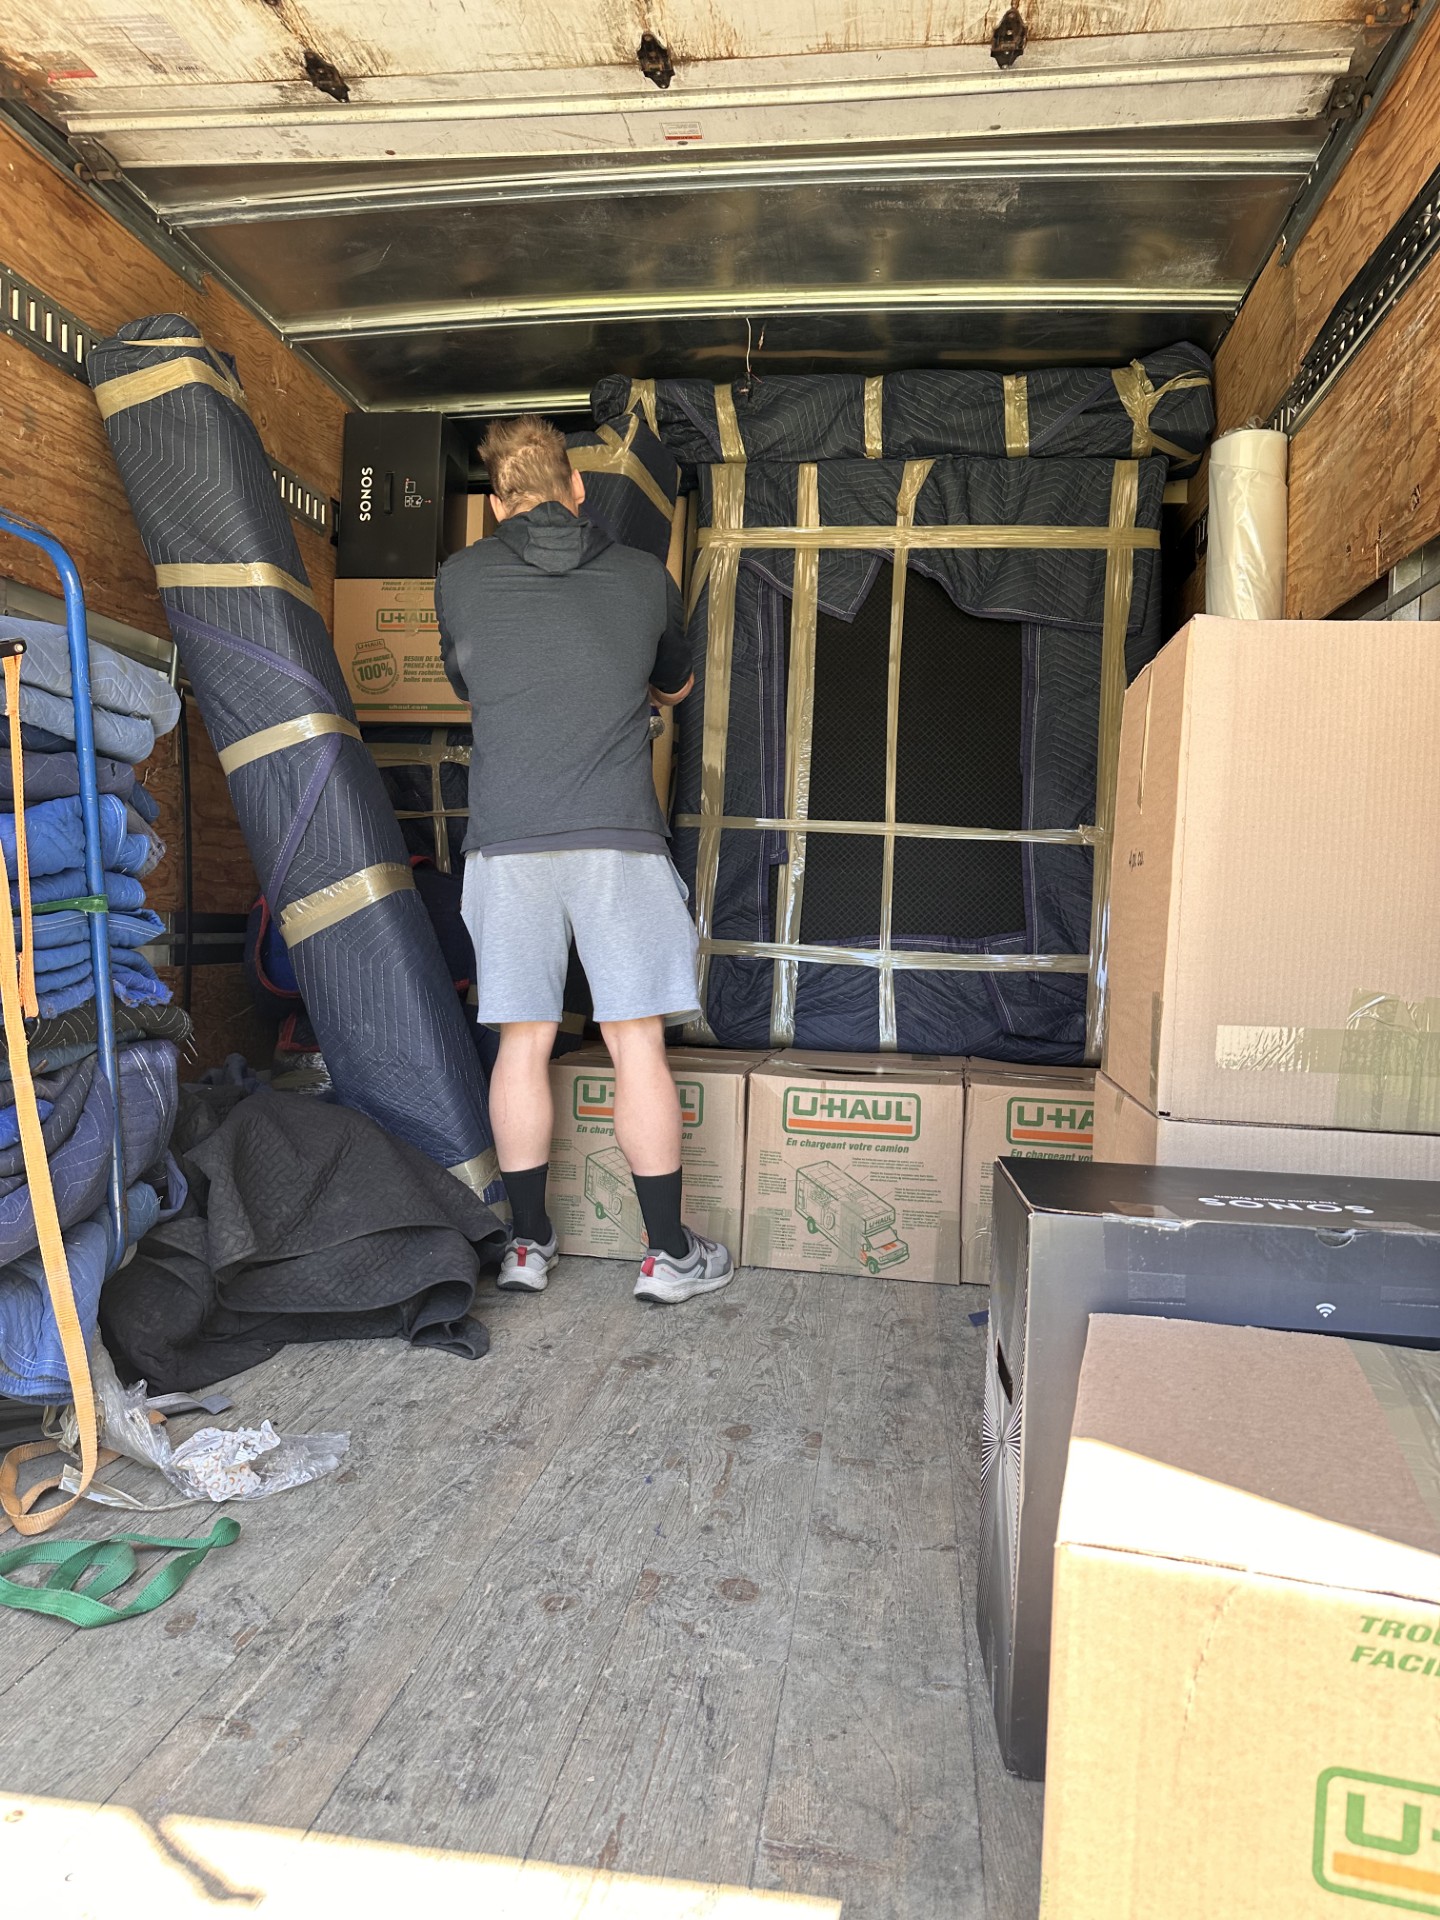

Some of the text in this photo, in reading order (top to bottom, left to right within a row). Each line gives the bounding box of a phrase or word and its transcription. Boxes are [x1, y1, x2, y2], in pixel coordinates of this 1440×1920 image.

[359, 466, 373, 522] SONOS
[380, 612, 438, 623] U-HAUL
[356, 661, 394, 682] 100%
[792, 1095, 912, 1122] U-HAUL
[576, 1124, 588, 1133] En
[786, 1138, 910, 1154] En chargeant votre camion
[1197, 1197, 1375, 1215] SONOS
